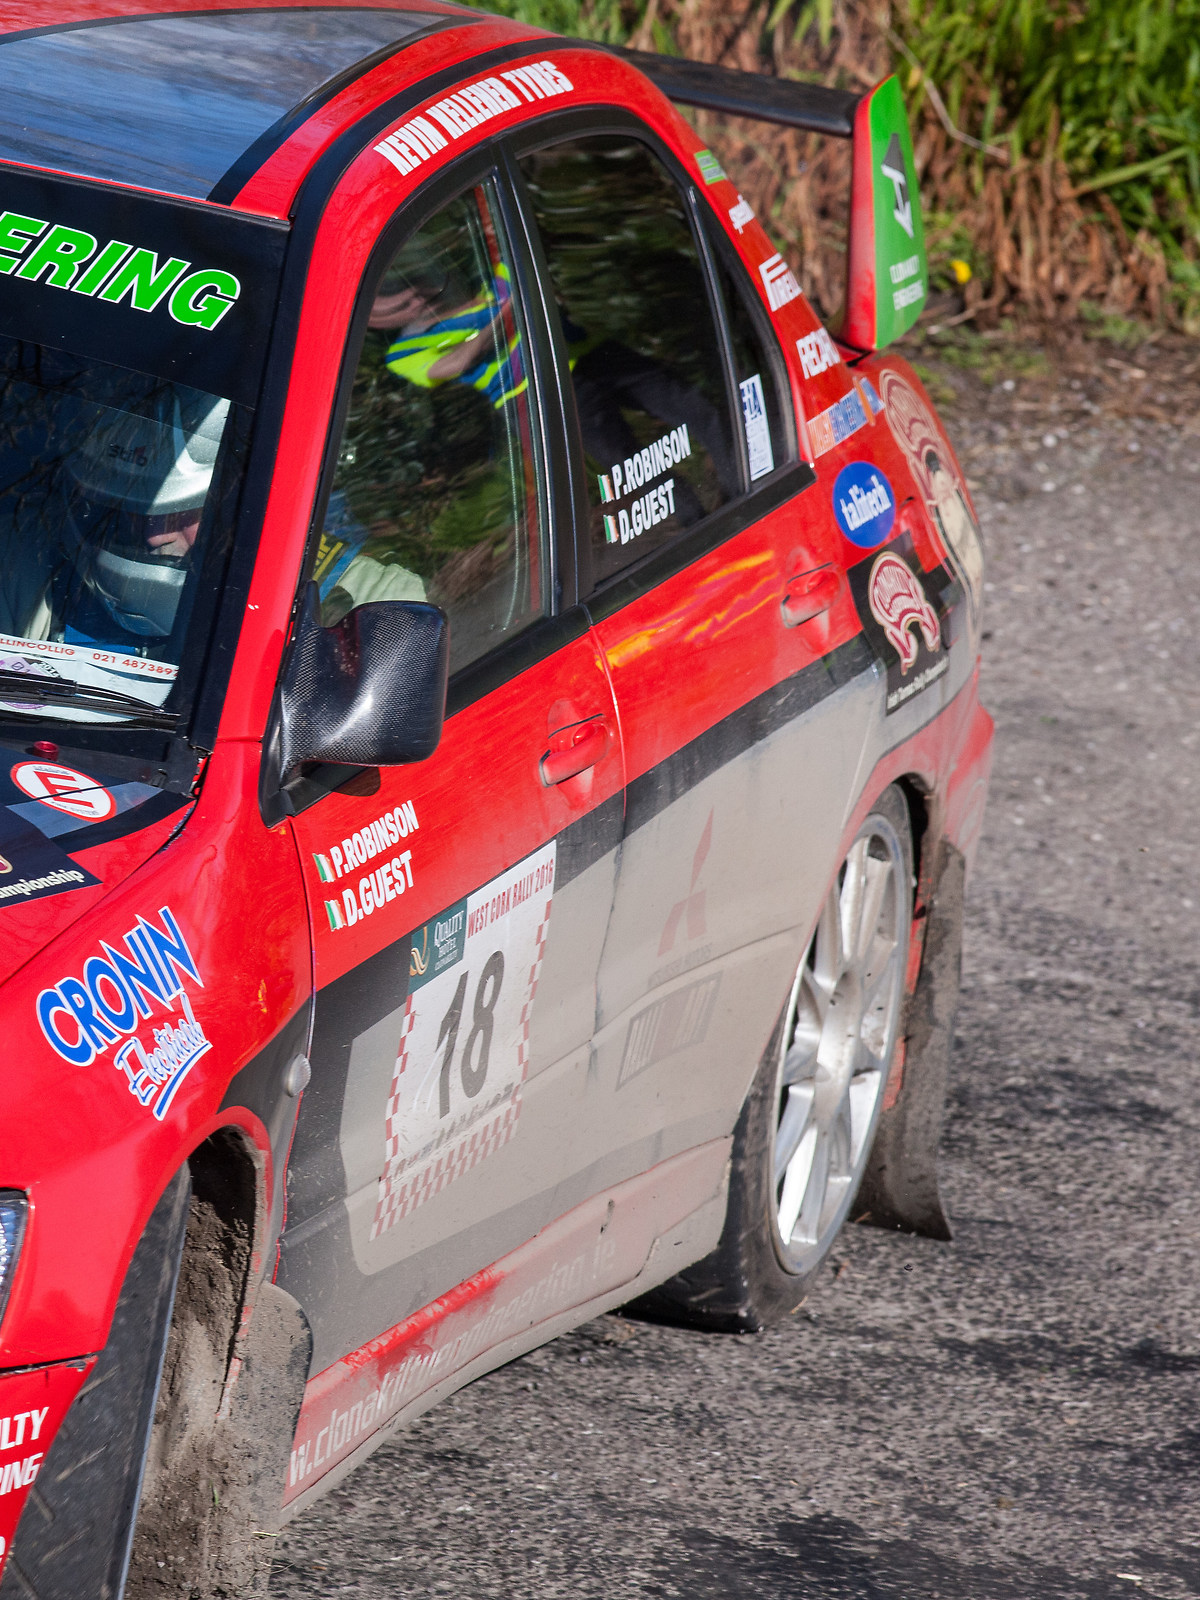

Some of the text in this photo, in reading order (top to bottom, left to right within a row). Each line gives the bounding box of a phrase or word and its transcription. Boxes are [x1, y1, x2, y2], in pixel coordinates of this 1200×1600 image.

[373, 60, 574, 177] KEVIN KELLEHER TYRES
[611, 423, 692, 501] P.ROBINSON
[617, 478, 676, 546] D.GUEST
[92, 652, 116, 665] 021
[329, 800, 419, 878] P.ROBINSON
[341, 850, 415, 927] D.GUEST
[467, 858, 554, 939] WEST CORK RALLY 2016
[36, 905, 204, 1066] CRONIN
[435, 950, 505, 1120] 18
